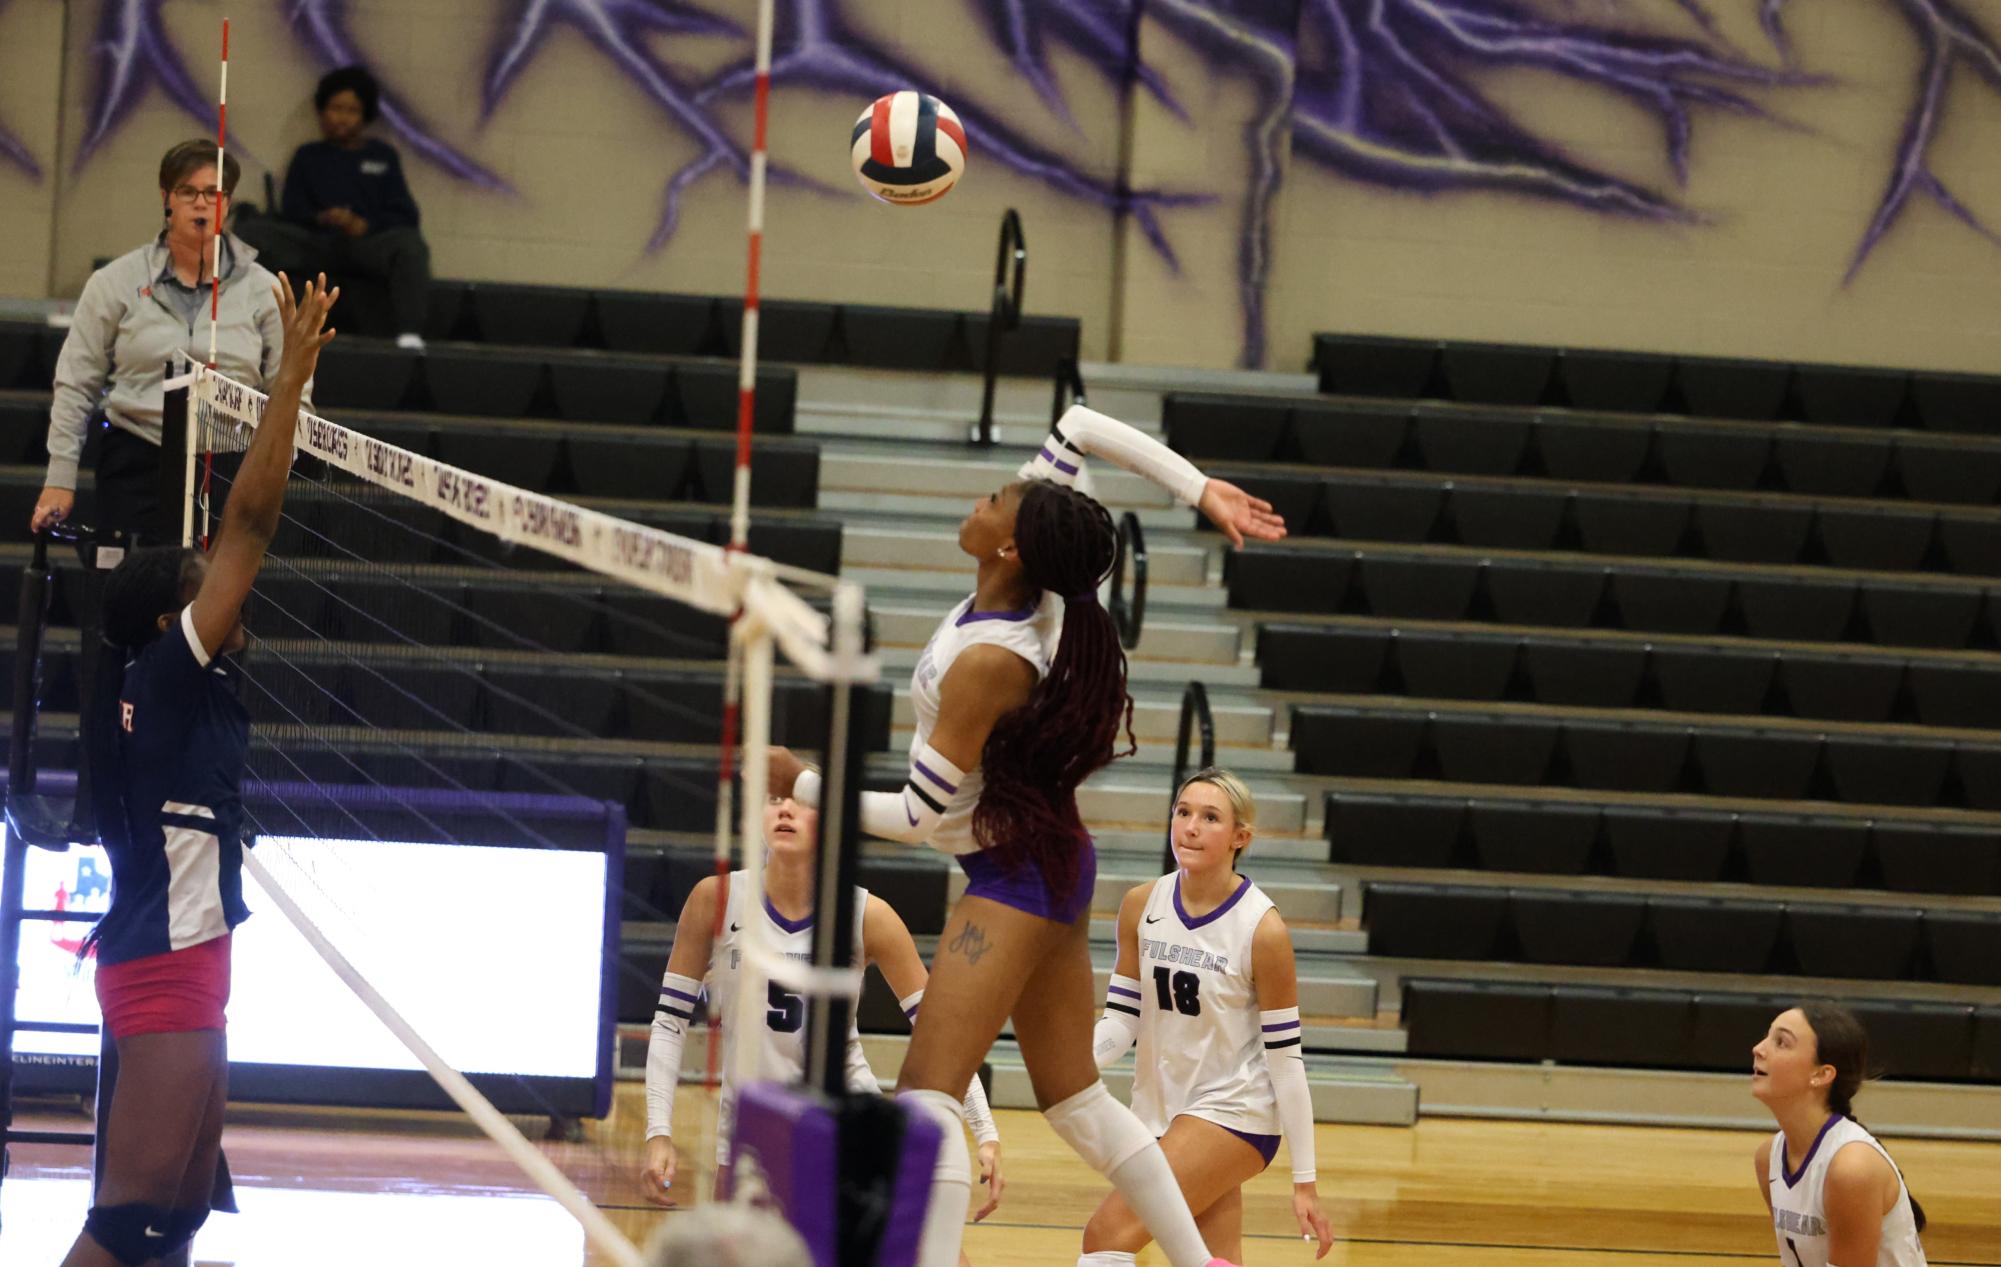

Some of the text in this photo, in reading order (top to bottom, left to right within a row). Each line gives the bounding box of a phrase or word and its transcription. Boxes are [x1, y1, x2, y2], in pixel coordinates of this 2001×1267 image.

[1141, 938, 1229, 975] FULSHEAR
[766, 979, 804, 1034] 5
[1153, 965, 1201, 1017] 18
